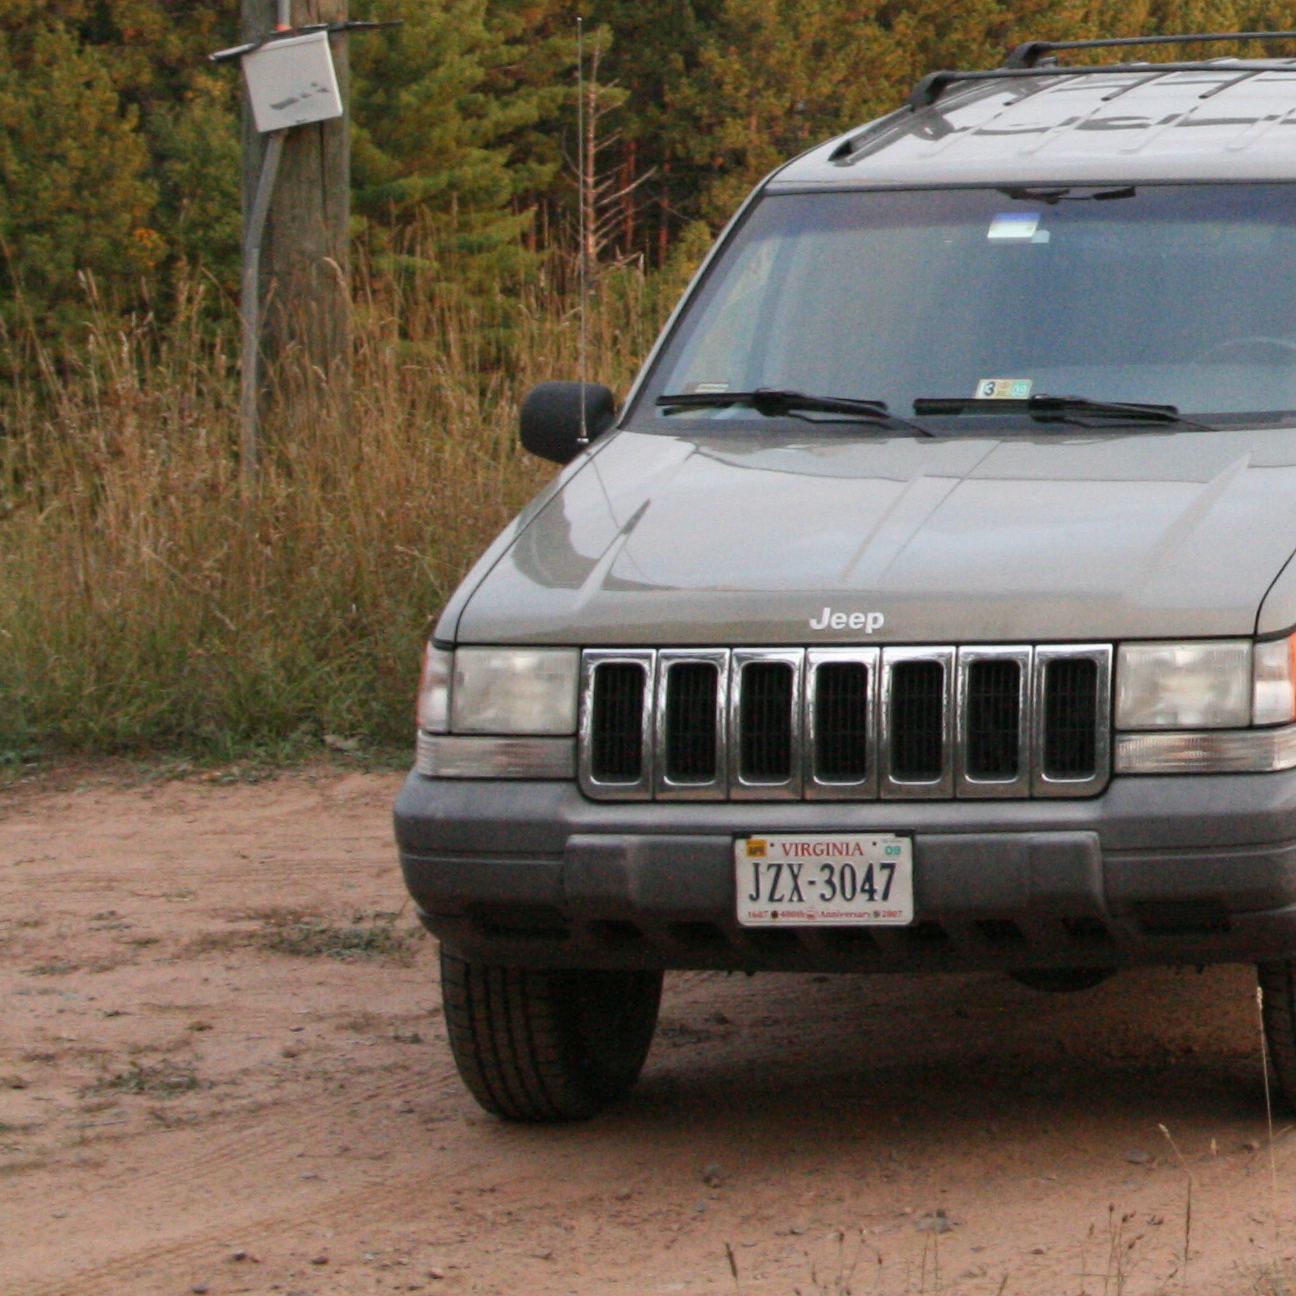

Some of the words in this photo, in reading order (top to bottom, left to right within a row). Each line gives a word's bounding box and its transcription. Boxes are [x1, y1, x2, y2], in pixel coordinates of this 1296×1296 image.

[983, 381, 996, 397] 3
[808, 607, 885, 634] Jeep
[781, 842, 865, 856] VIRGINIA
[885, 846, 902, 855] 09
[749, 862, 898, 902] JZX-3047
